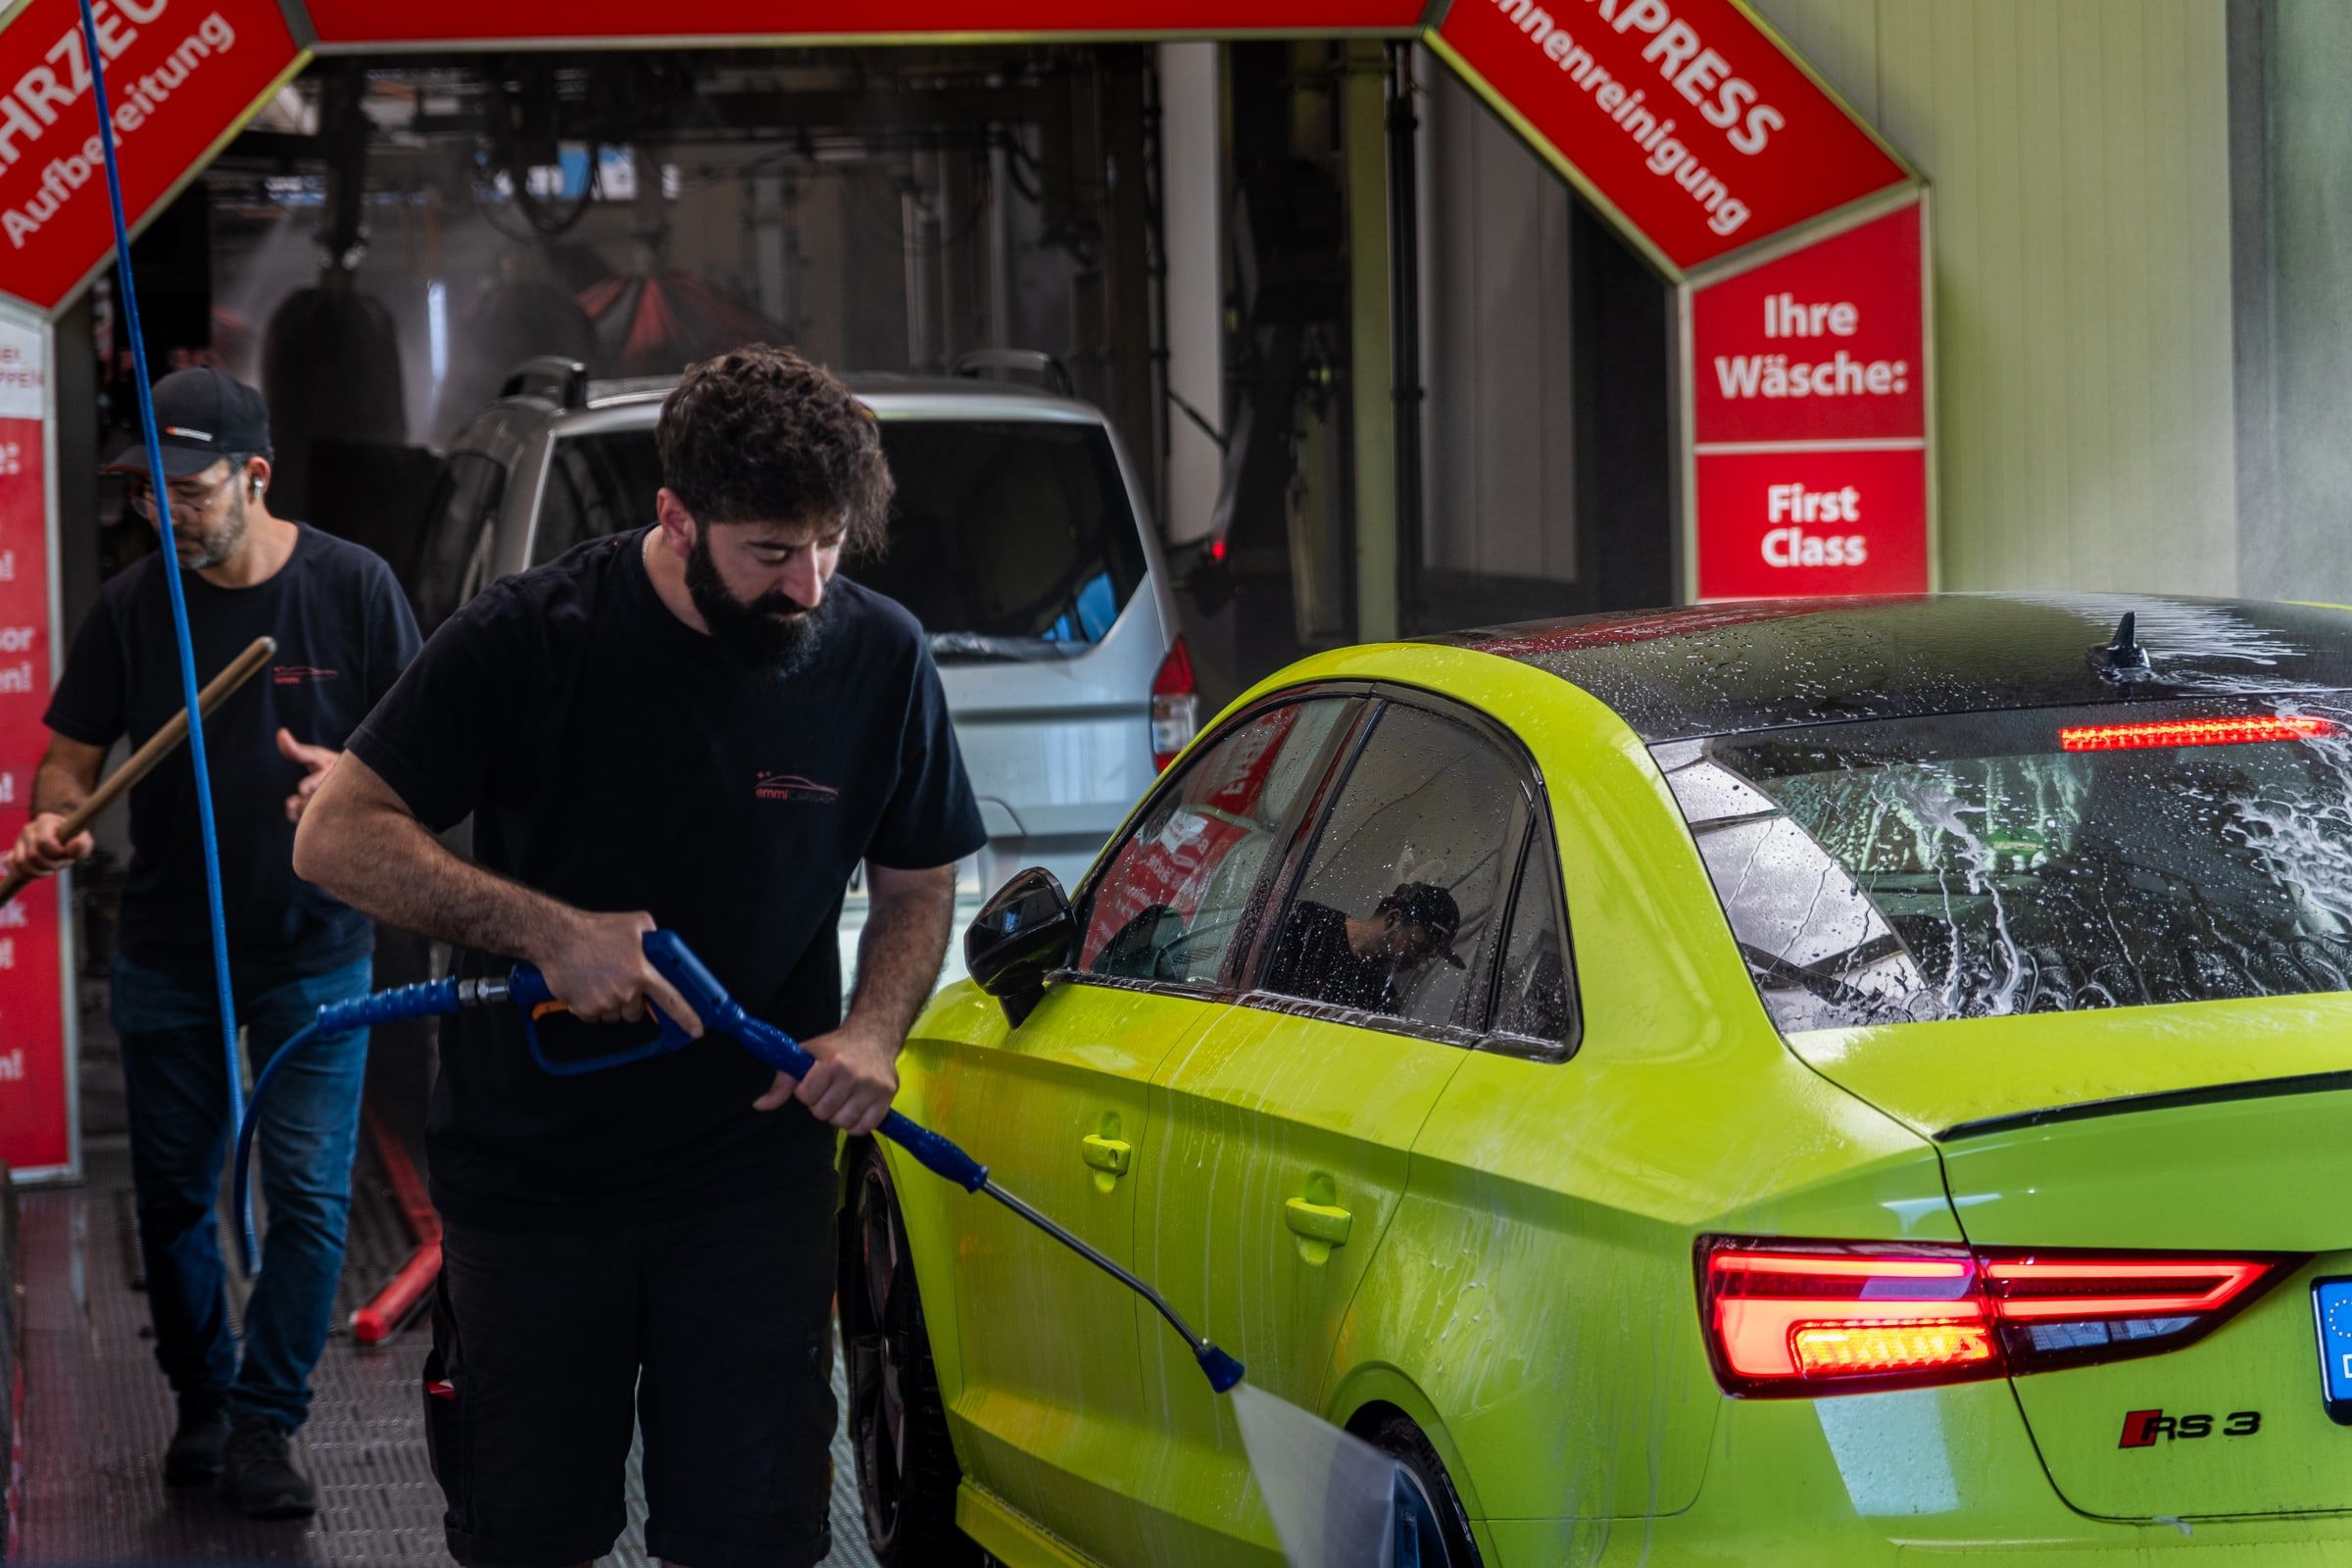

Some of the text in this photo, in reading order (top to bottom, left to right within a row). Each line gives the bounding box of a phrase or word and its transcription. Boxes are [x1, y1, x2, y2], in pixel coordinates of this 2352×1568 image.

[0, 0, 168, 177] HRZEU
[1491, 0, 1751, 236] nnenreinigung
[1764, 292, 1858, 337] Ihre
[1714, 350, 1908, 399] Wäsche:
[1768, 483, 1860, 522] First
[1761, 526, 1867, 567] Class
[2140, 1411, 2261, 1441] RS 3
